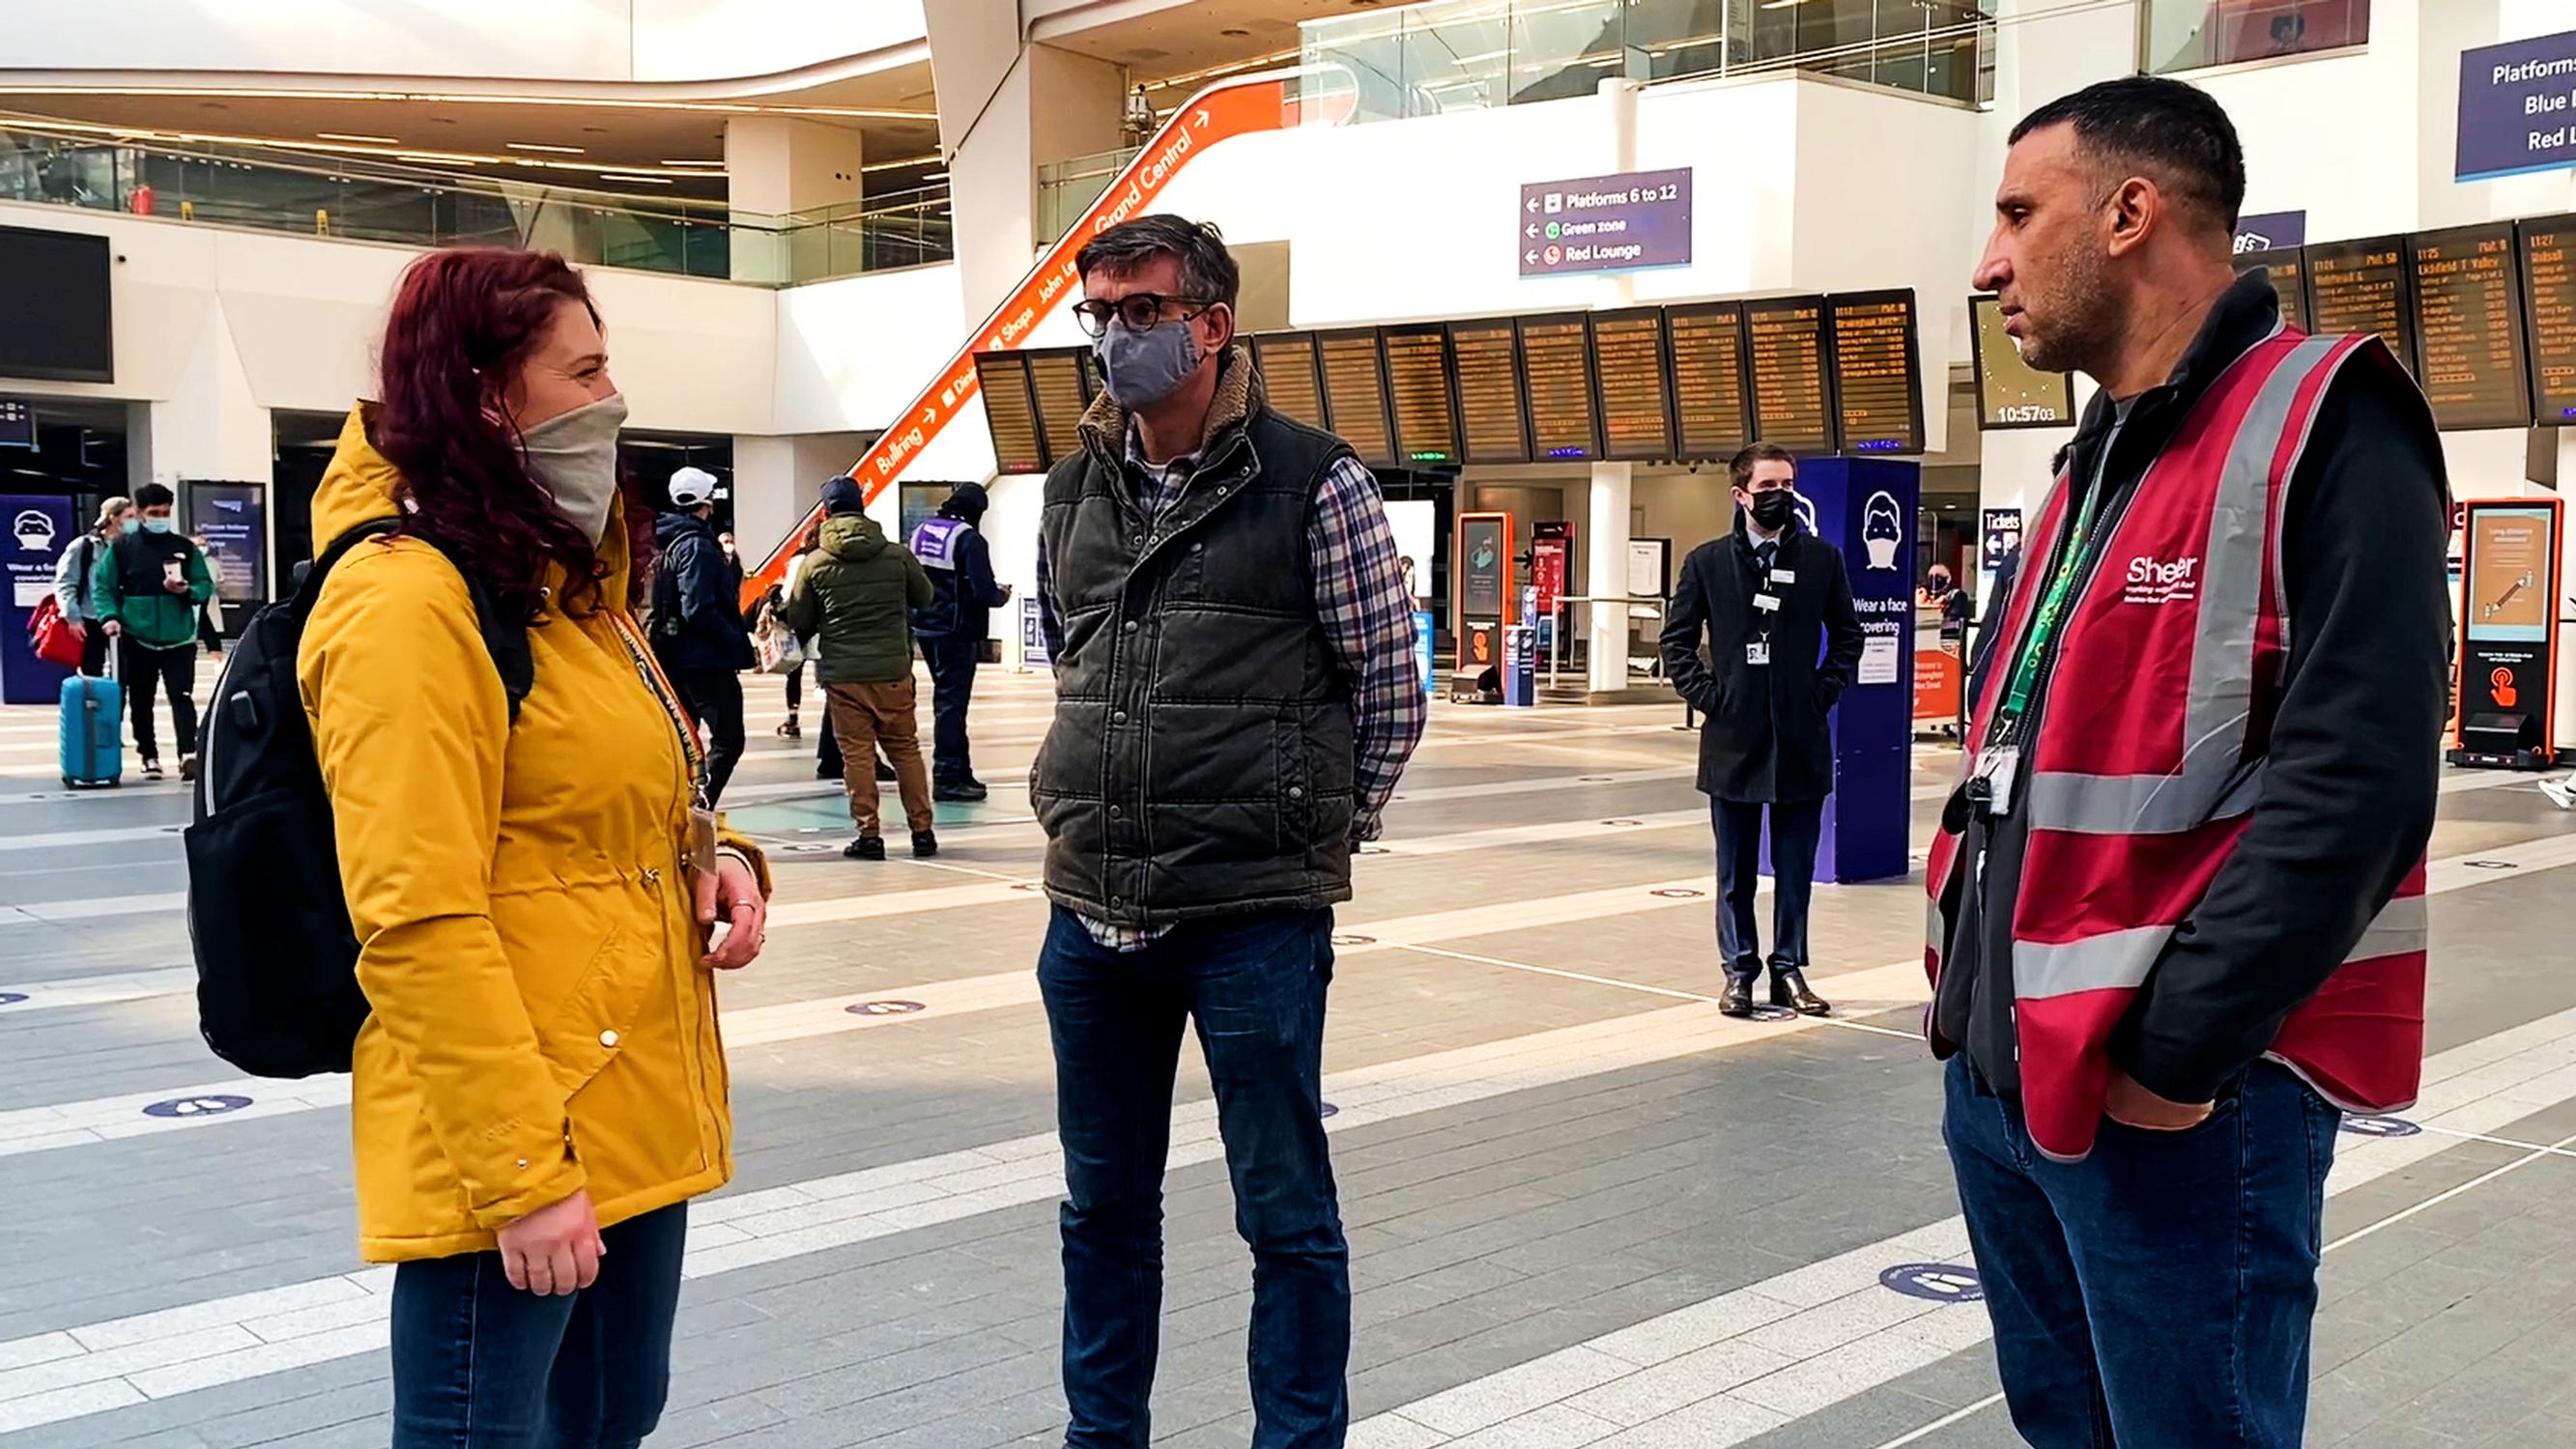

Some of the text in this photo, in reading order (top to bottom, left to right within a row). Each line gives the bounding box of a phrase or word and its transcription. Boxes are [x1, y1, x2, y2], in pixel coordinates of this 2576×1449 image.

[2525, 93, 2567, 115] Blue
[2528, 127, 2564, 151] Red
[1094, 125, 1193, 234] Grand Central
[1566, 184, 1677, 209] Platforms 6 to 12
[1561, 220, 1626, 236] Green zone
[1566, 244, 1642, 262] Red Lounge
[1038, 274, 1064, 304] John
[1001, 307, 1034, 342] Shops
[876, 426, 924, 476] Bullring
[1986, 513, 2020, 530] Tickets
[1852, 597, 1908, 612] Wear a face
